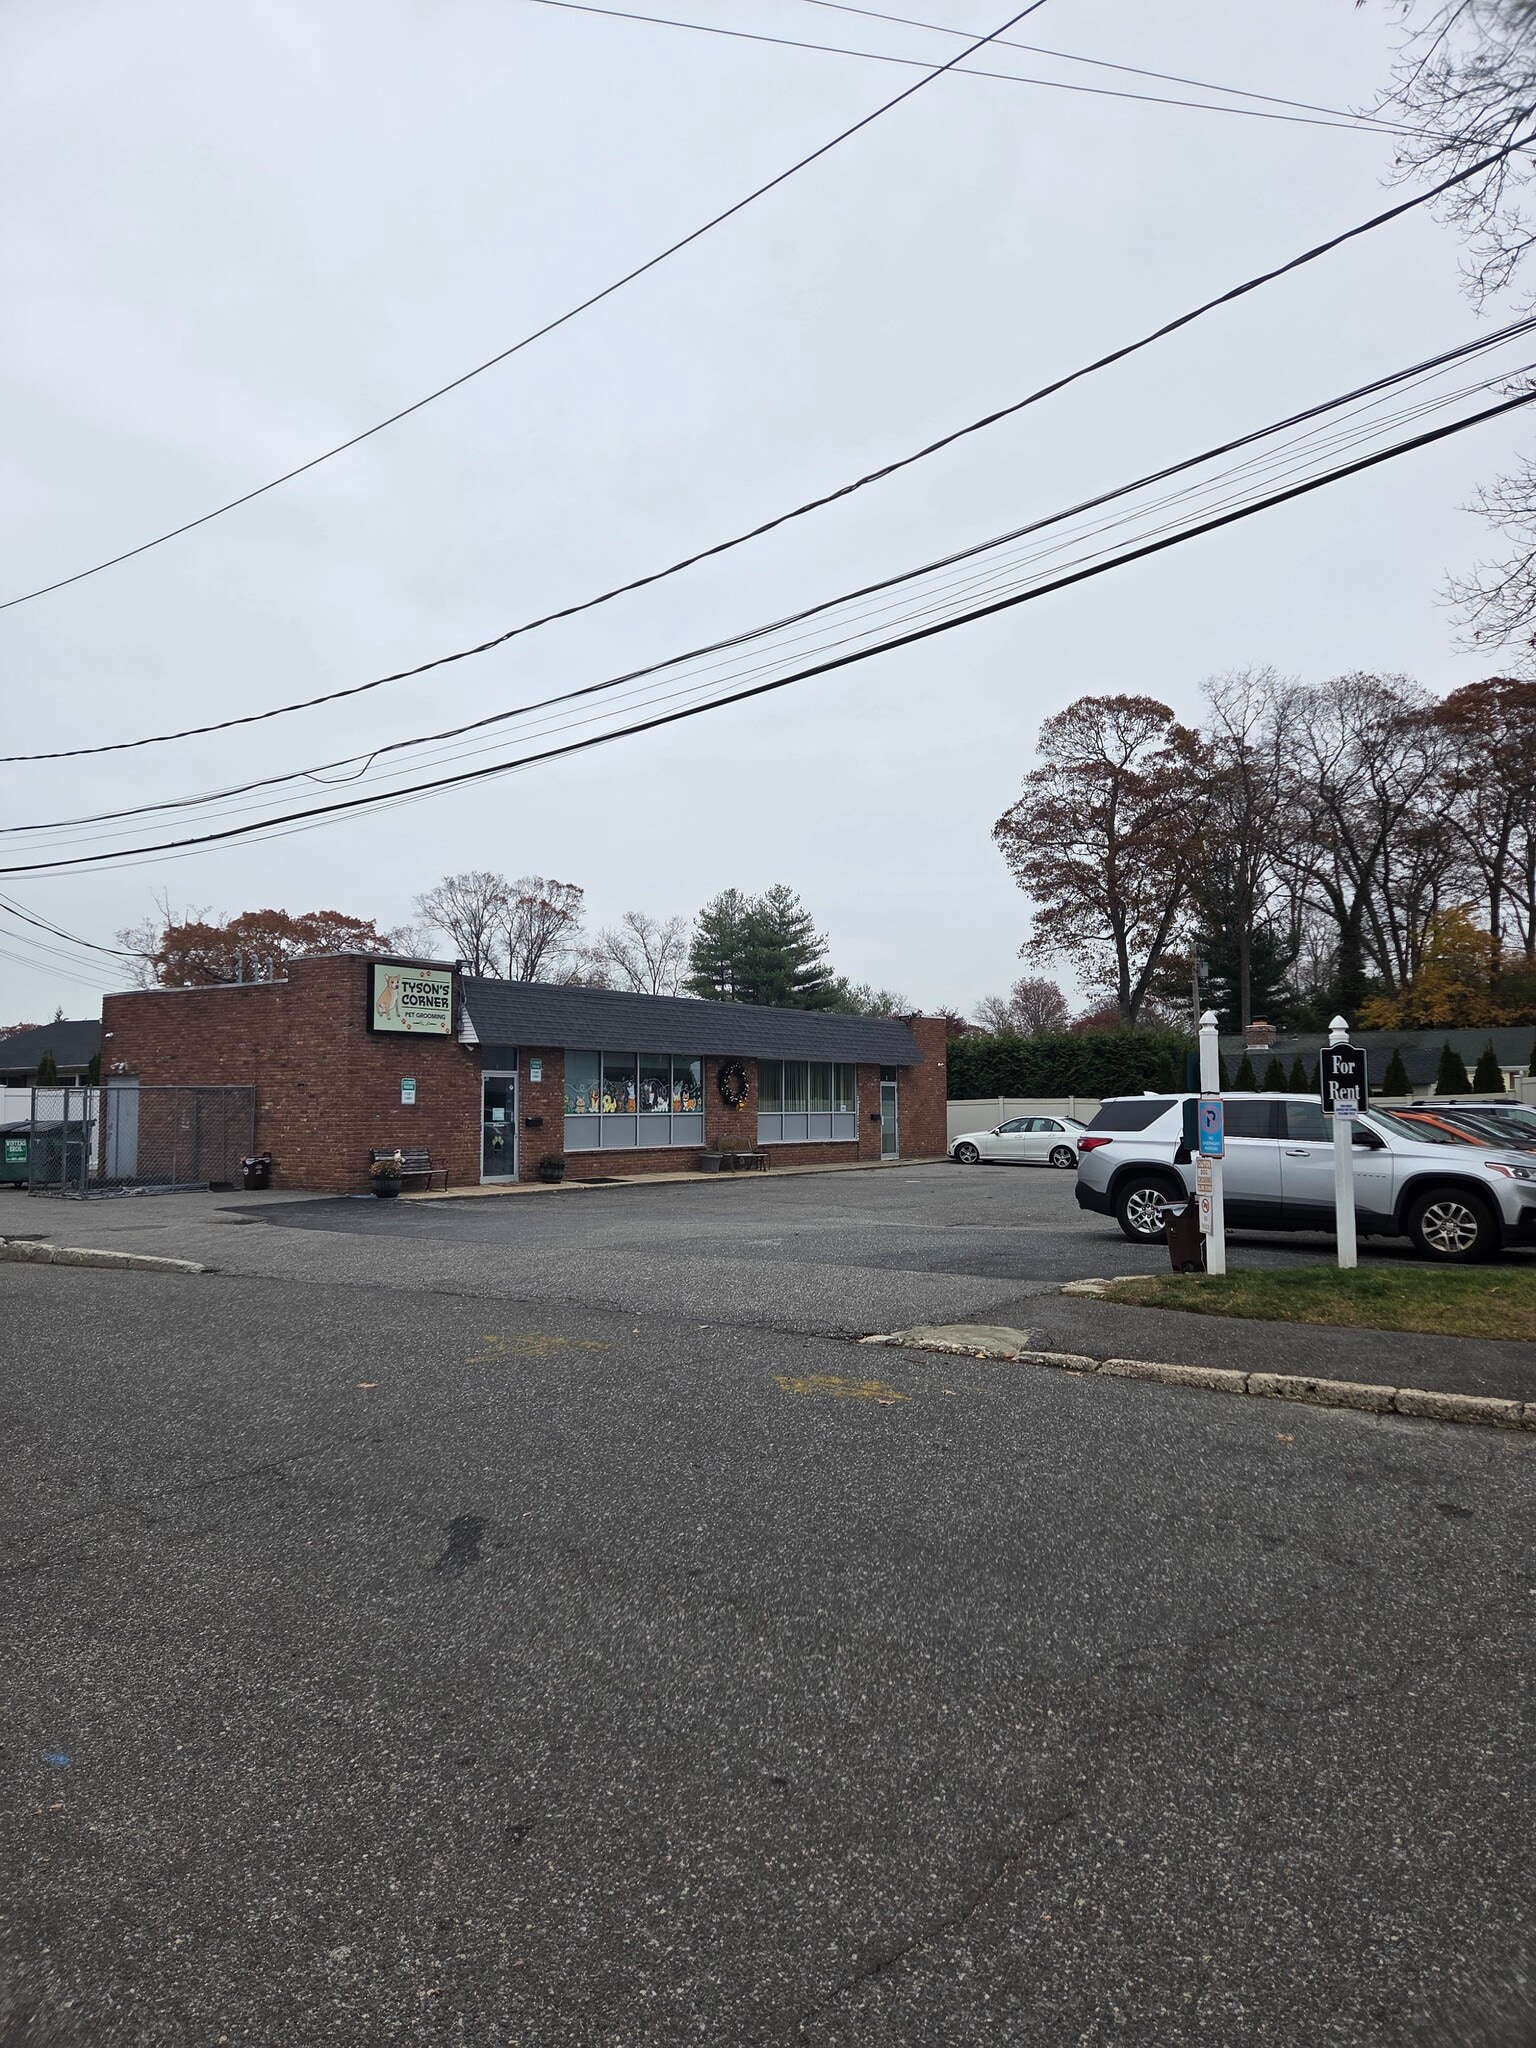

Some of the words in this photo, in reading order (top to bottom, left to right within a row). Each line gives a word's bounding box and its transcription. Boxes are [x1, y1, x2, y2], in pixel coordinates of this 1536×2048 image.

[401, 982, 450, 995] TYSON'S
[401, 994, 448, 1008] CORNER
[416, 1012, 446, 1020] GROOMING
[1331, 1055, 1356, 1074] For
[1328, 1081, 1361, 1100] Rent
